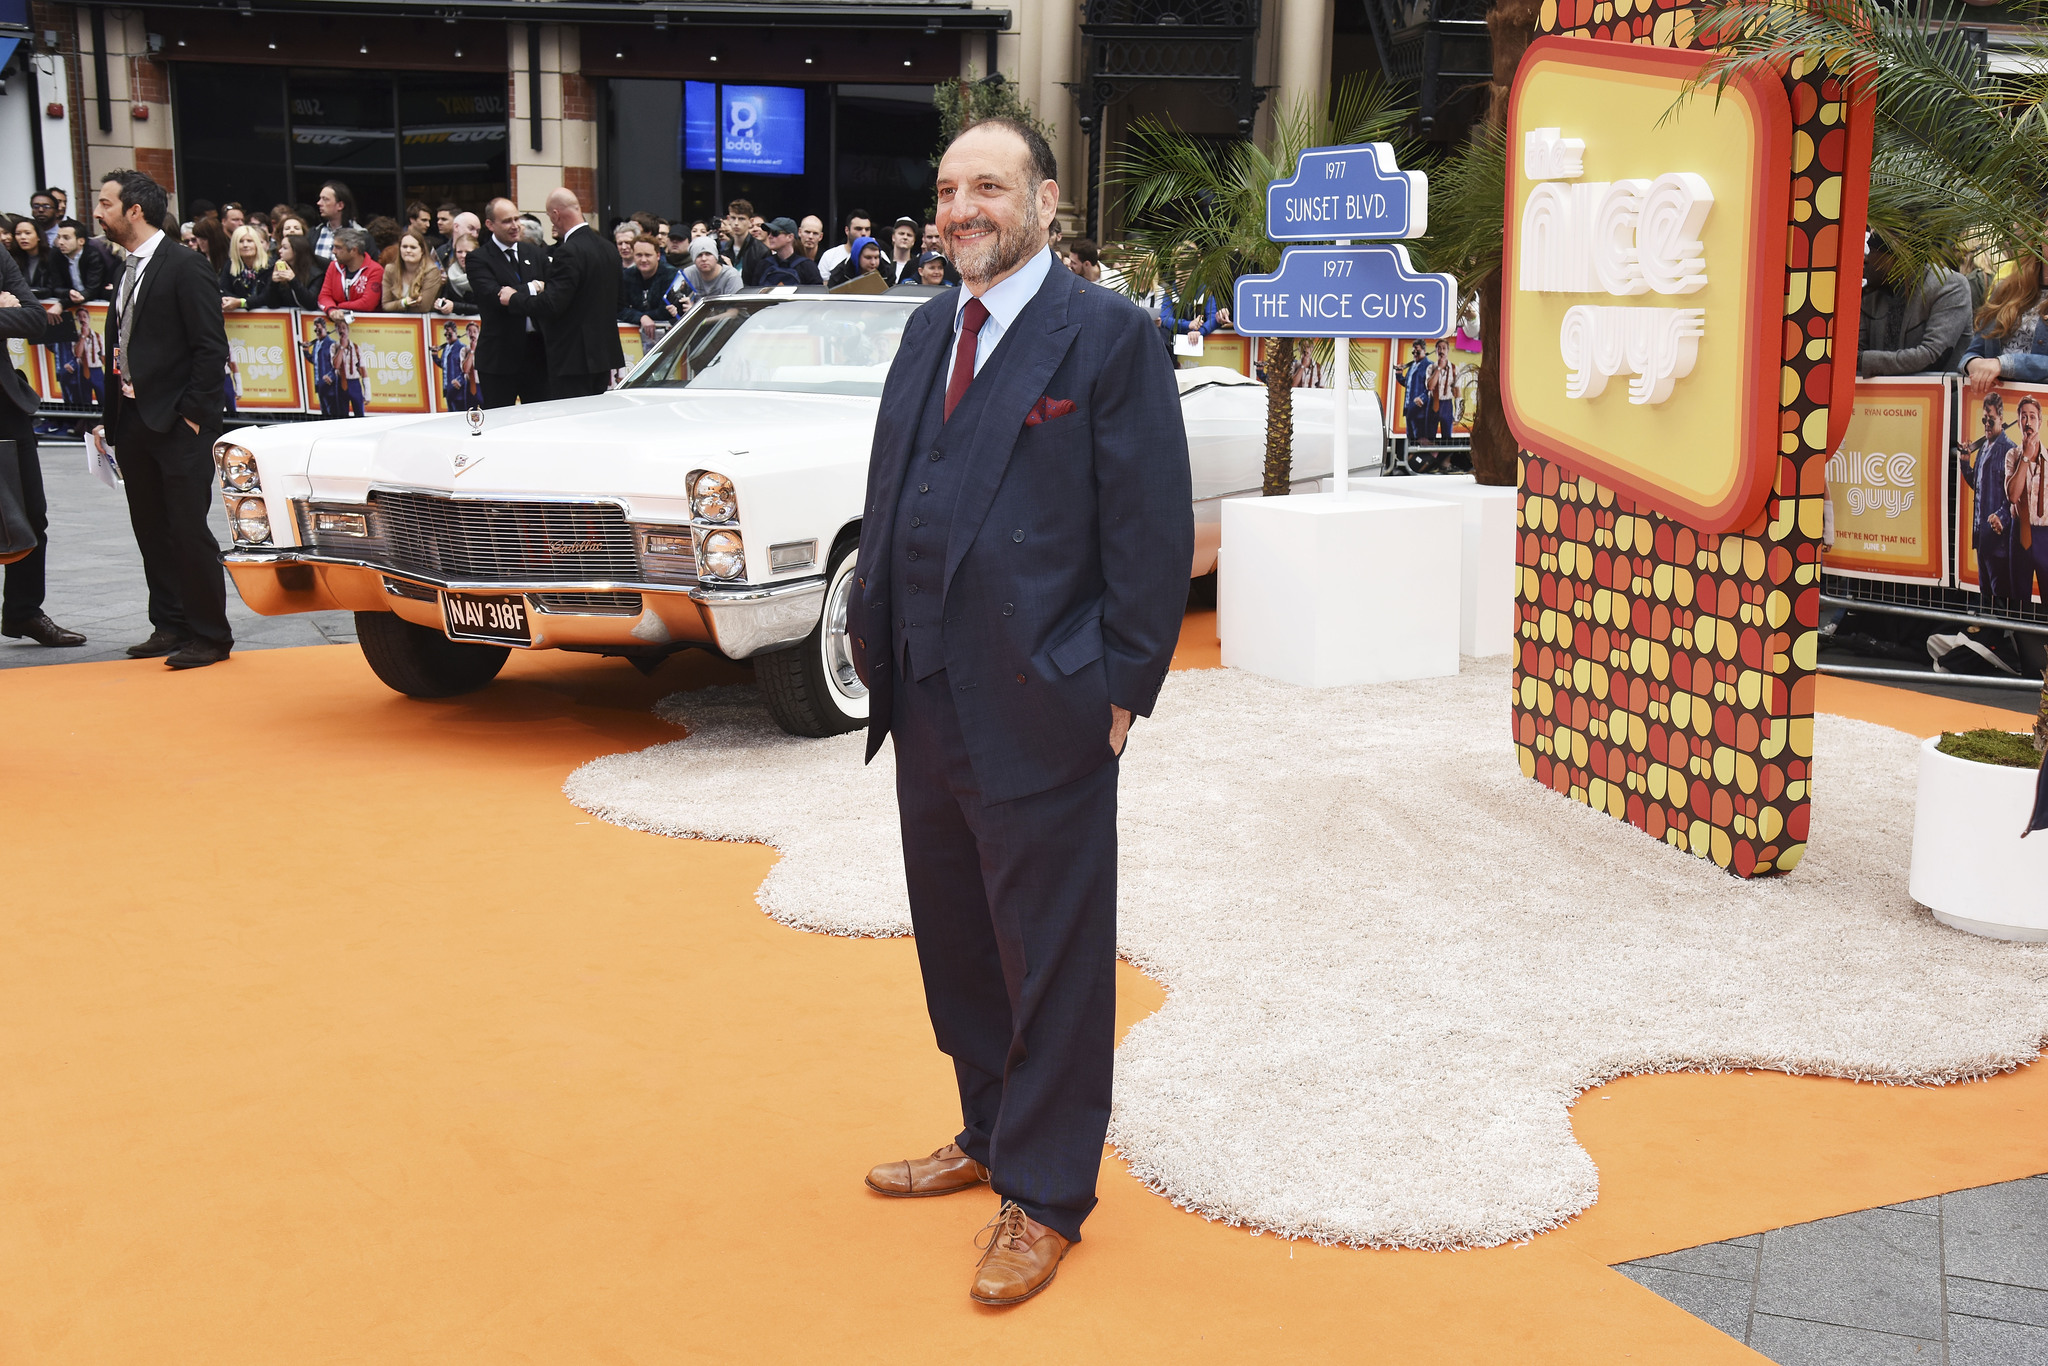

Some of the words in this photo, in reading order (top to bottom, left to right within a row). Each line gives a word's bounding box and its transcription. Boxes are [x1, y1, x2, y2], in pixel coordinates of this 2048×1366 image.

[1524, 127, 1585, 180] the
[1325, 161, 1347, 180] 1977
[1285, 196, 1340, 222] SUNSET
[1345, 193, 1388, 220] BLVD.
[1323, 260, 1353, 277] 1977
[1252, 293, 1290, 318] THE
[1300, 293, 1353, 318] NICE
[1361, 293, 1427, 318] GUYS
[1883, 409, 1918, 417] GOSLING
[1847, 487, 1915, 519] guys
[1836, 530, 1862, 540] THEY'RE
[1863, 533, 1879, 542] NOT
[1880, 534, 1898, 543] THAT
[1899, 536, 1916, 545] NICE
[1863, 542, 1880, 551] JUNE
[1881, 544, 1886, 552] 3
[550, 540, 603, 555] Cadillac
[450, 599, 484, 627] NAV
[485, 602, 524, 631] 318F
